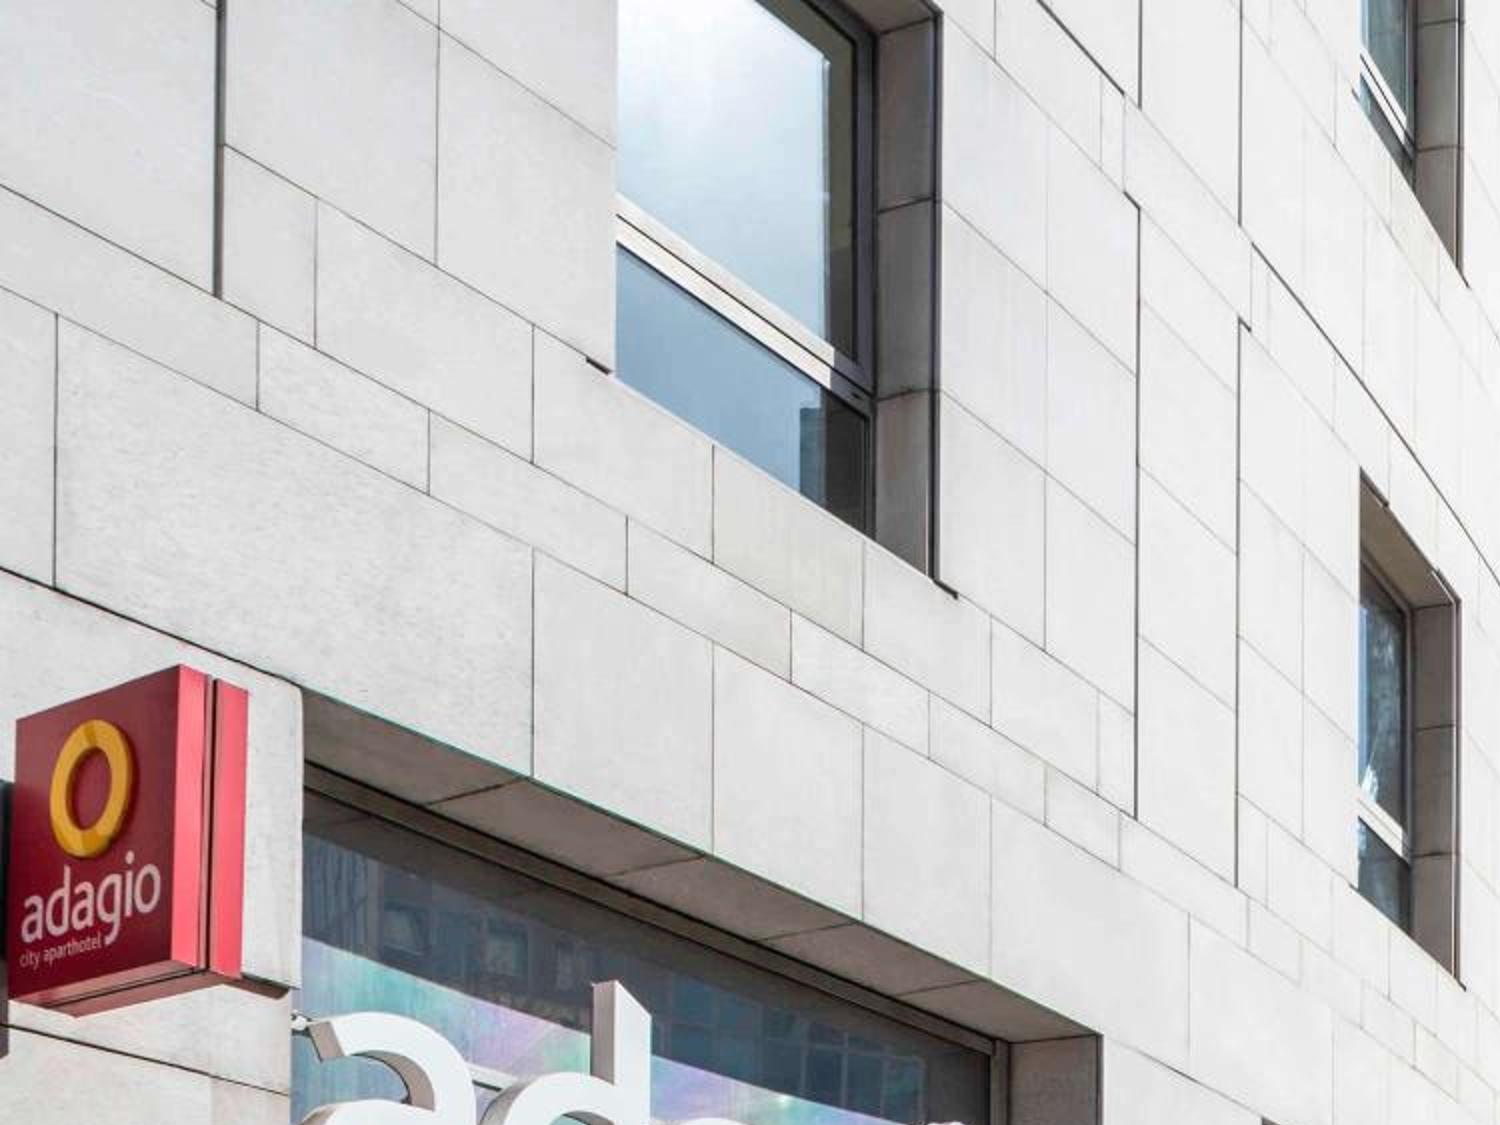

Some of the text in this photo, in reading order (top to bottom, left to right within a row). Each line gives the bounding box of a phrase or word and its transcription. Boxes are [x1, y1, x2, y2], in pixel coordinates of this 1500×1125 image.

[20, 850, 162, 945] adagio
[19, 931, 102, 971] city aparthotel
